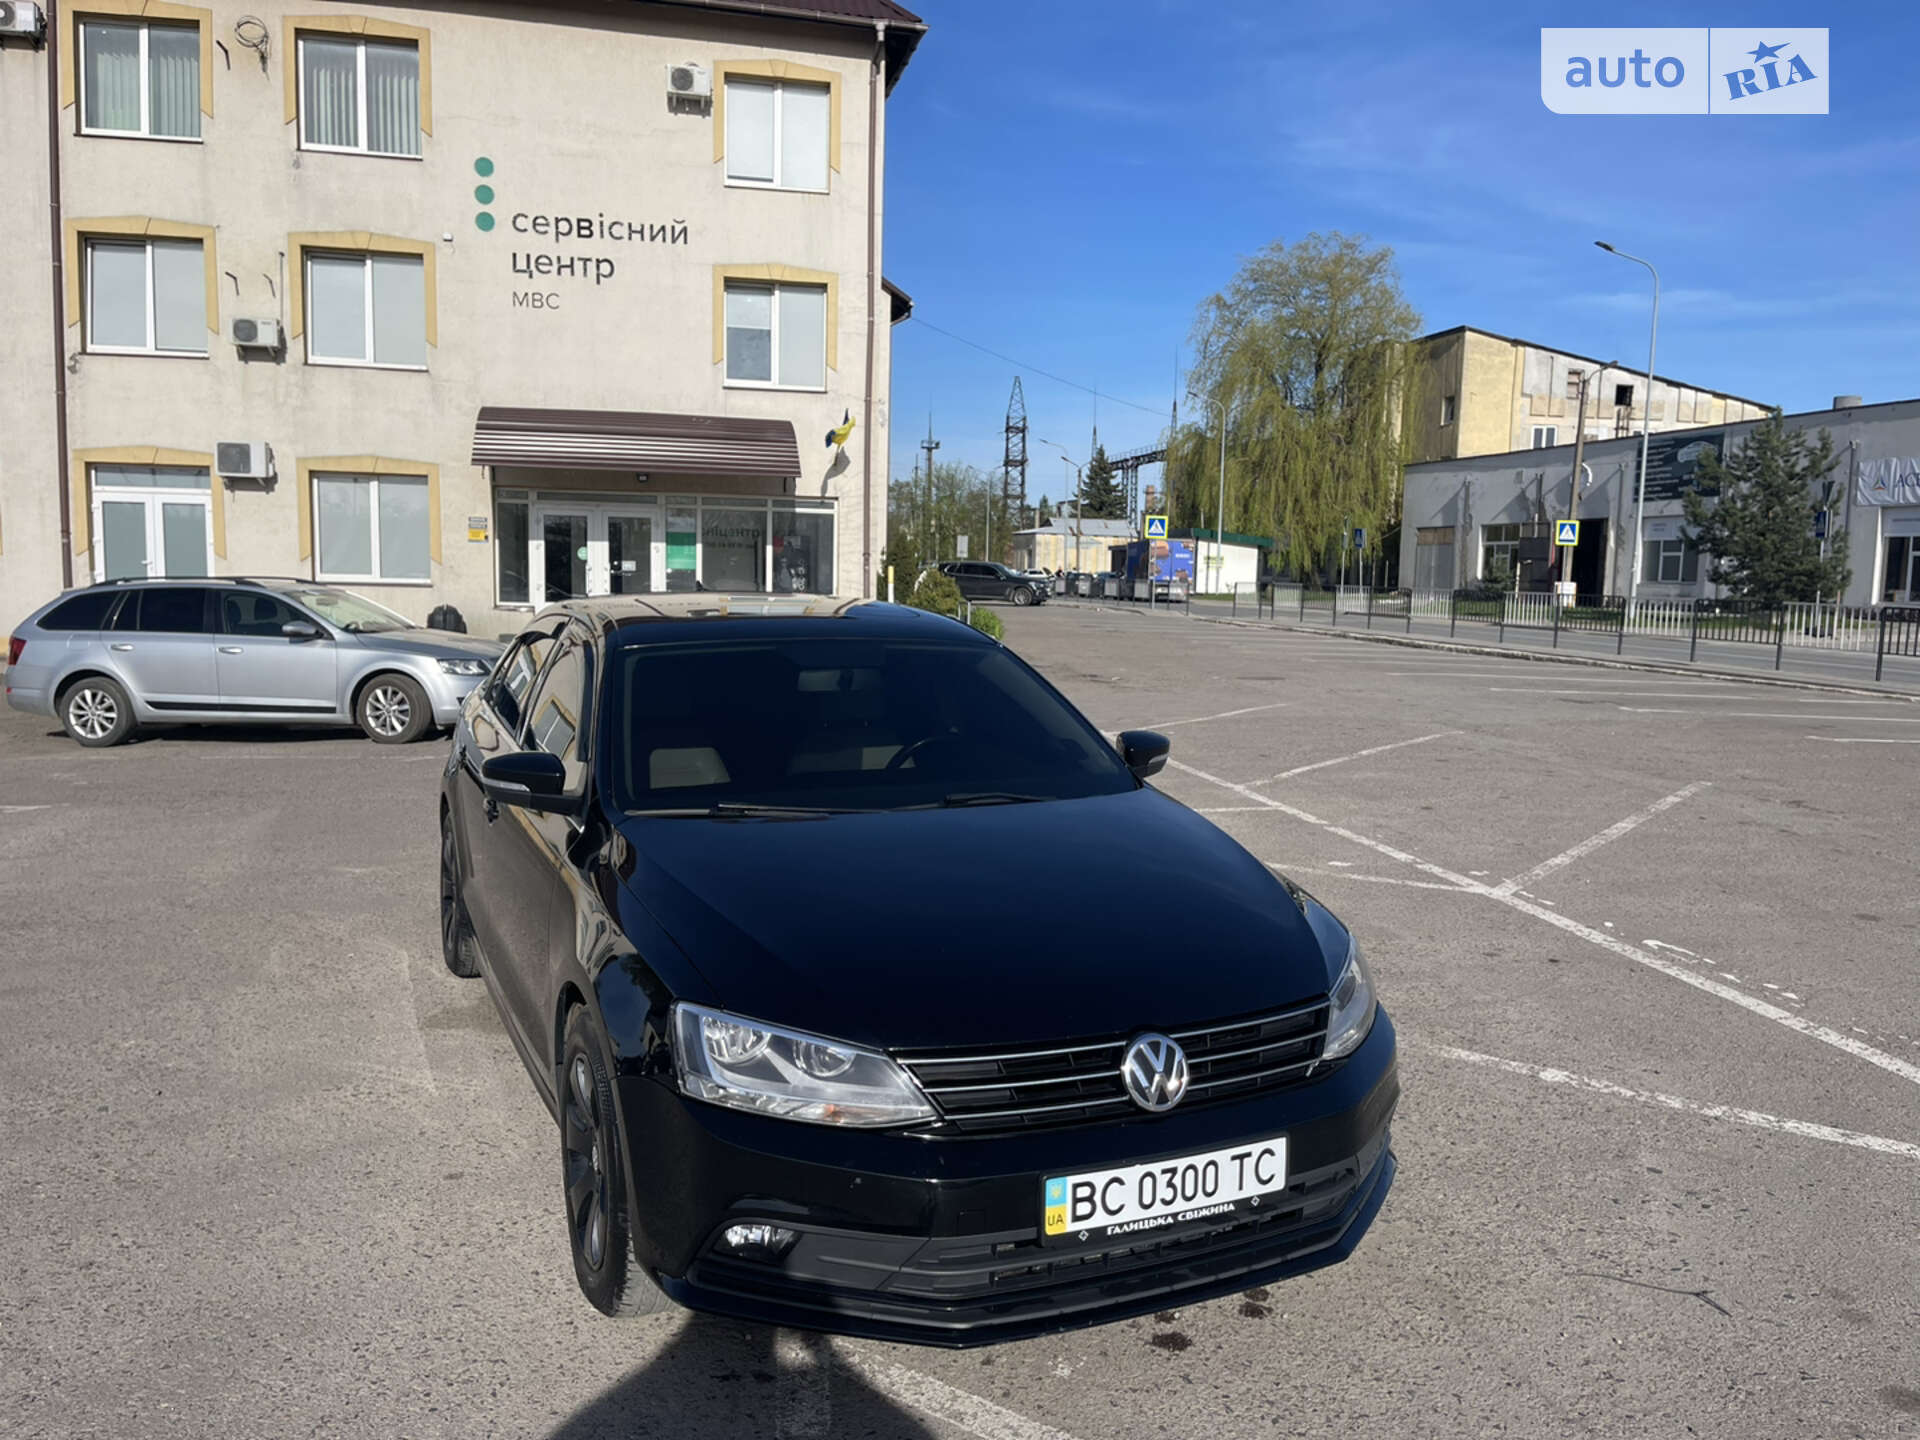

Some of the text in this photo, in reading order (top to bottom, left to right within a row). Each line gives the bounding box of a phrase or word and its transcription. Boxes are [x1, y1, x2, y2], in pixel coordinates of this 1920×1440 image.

[511, 212, 689, 246] сервісний
[511, 251, 616, 286] центр
[512, 290, 561, 310] МВС
[1071, 1147, 1276, 1224] BC 0300 TC
[1047, 1213, 1065, 1227] UA
[1106, 1202, 1236, 1236] ГАЛИЦЬКА СВІЖИНА
